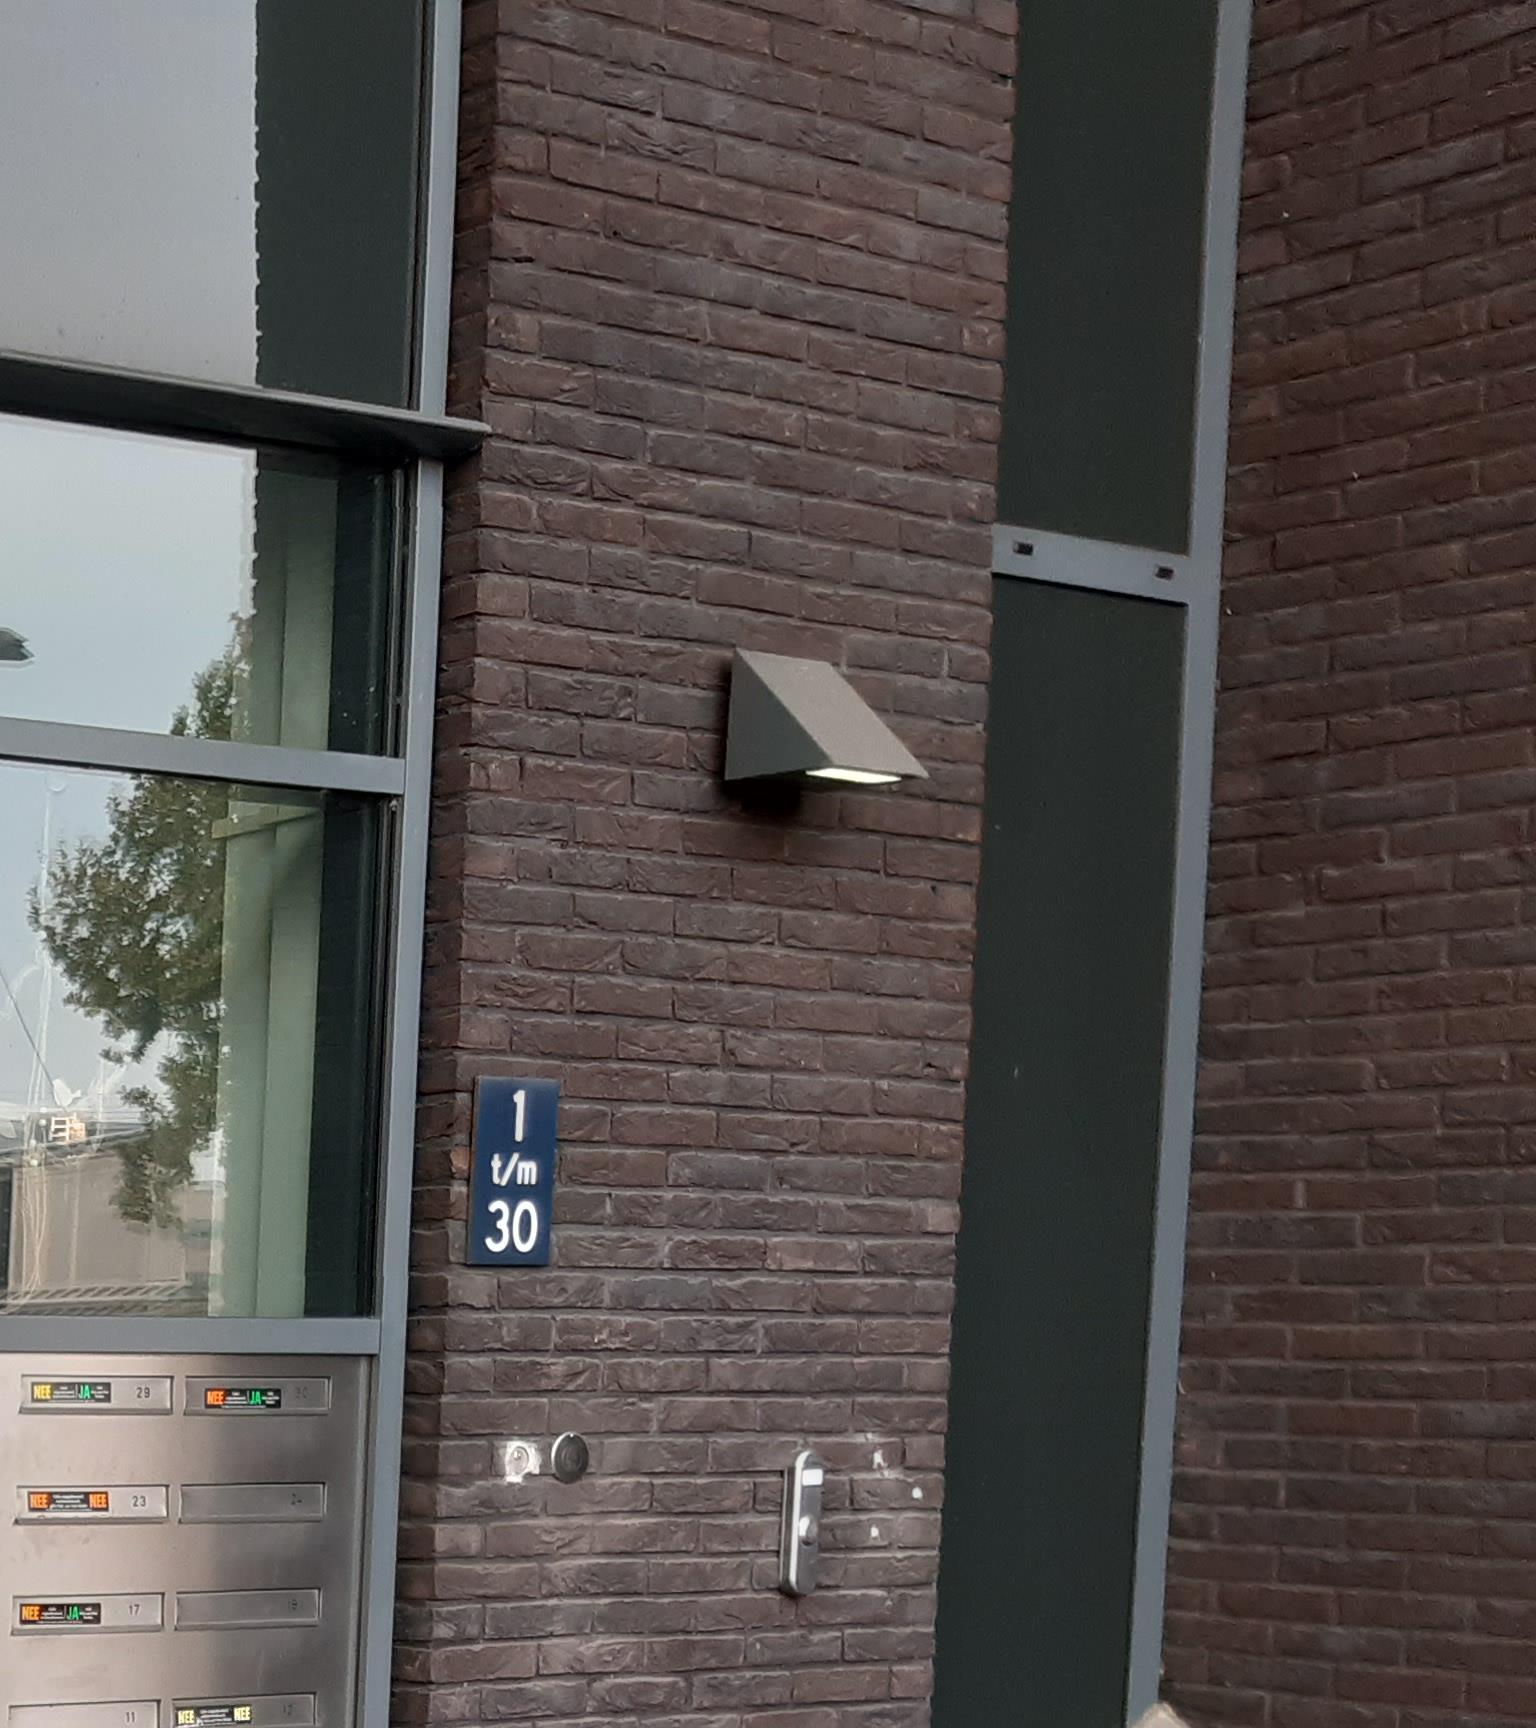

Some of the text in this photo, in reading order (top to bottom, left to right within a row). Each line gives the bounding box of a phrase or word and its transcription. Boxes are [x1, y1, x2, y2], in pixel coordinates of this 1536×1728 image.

[513, 1089, 526, 1143] 1
[490, 1152, 538, 1187] t/m
[484, 1199, 539, 1254] 30
[32, 1383, 52, 1400] NEE
[78, 1383, 91, 1400] JA
[135, 1386, 151, 1399] 29
[207, 1390, 225, 1406] NEE
[250, 1390, 262, 1406] JA
[29, 1493, 49, 1510] NEE
[89, 1493, 108, 1509] NEE
[131, 1495, 147, 1508] 23
[21, 1605, 41, 1621] NEE
[67, 1605, 81, 1621] JA
[128, 1603, 141, 1617] 17
[177, 1710, 195, 1725] NEE
[233, 1706, 251, 1722] NEE
